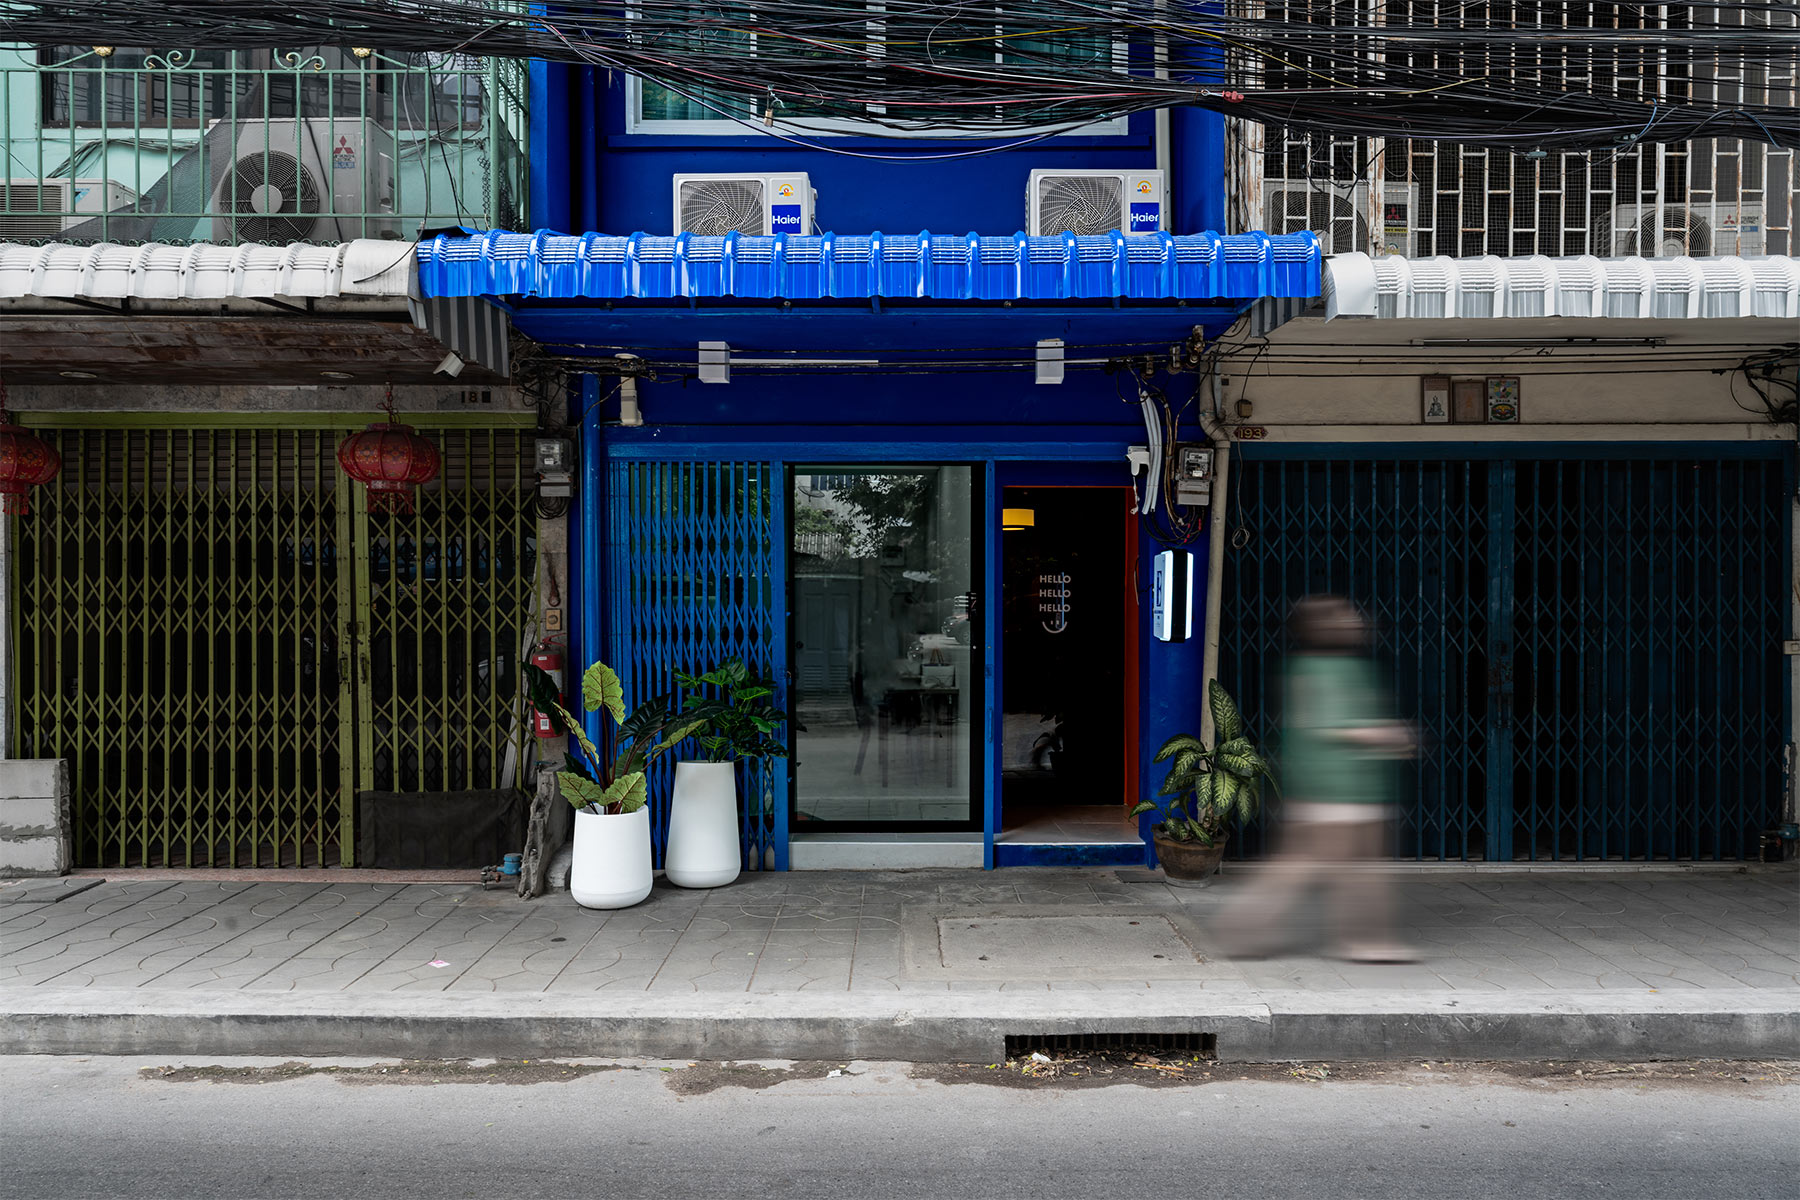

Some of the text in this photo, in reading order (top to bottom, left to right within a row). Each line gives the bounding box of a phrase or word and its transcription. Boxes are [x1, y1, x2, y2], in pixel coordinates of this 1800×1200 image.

[772, 214, 800, 224] Haier
[1131, 212, 1159, 222] Haier
[1240, 429, 1262, 439] 193
[1040, 575, 1071, 584] HELLO
[1039, 589, 1071, 598] HELLO
[1039, 603, 1071, 612] HELLO
